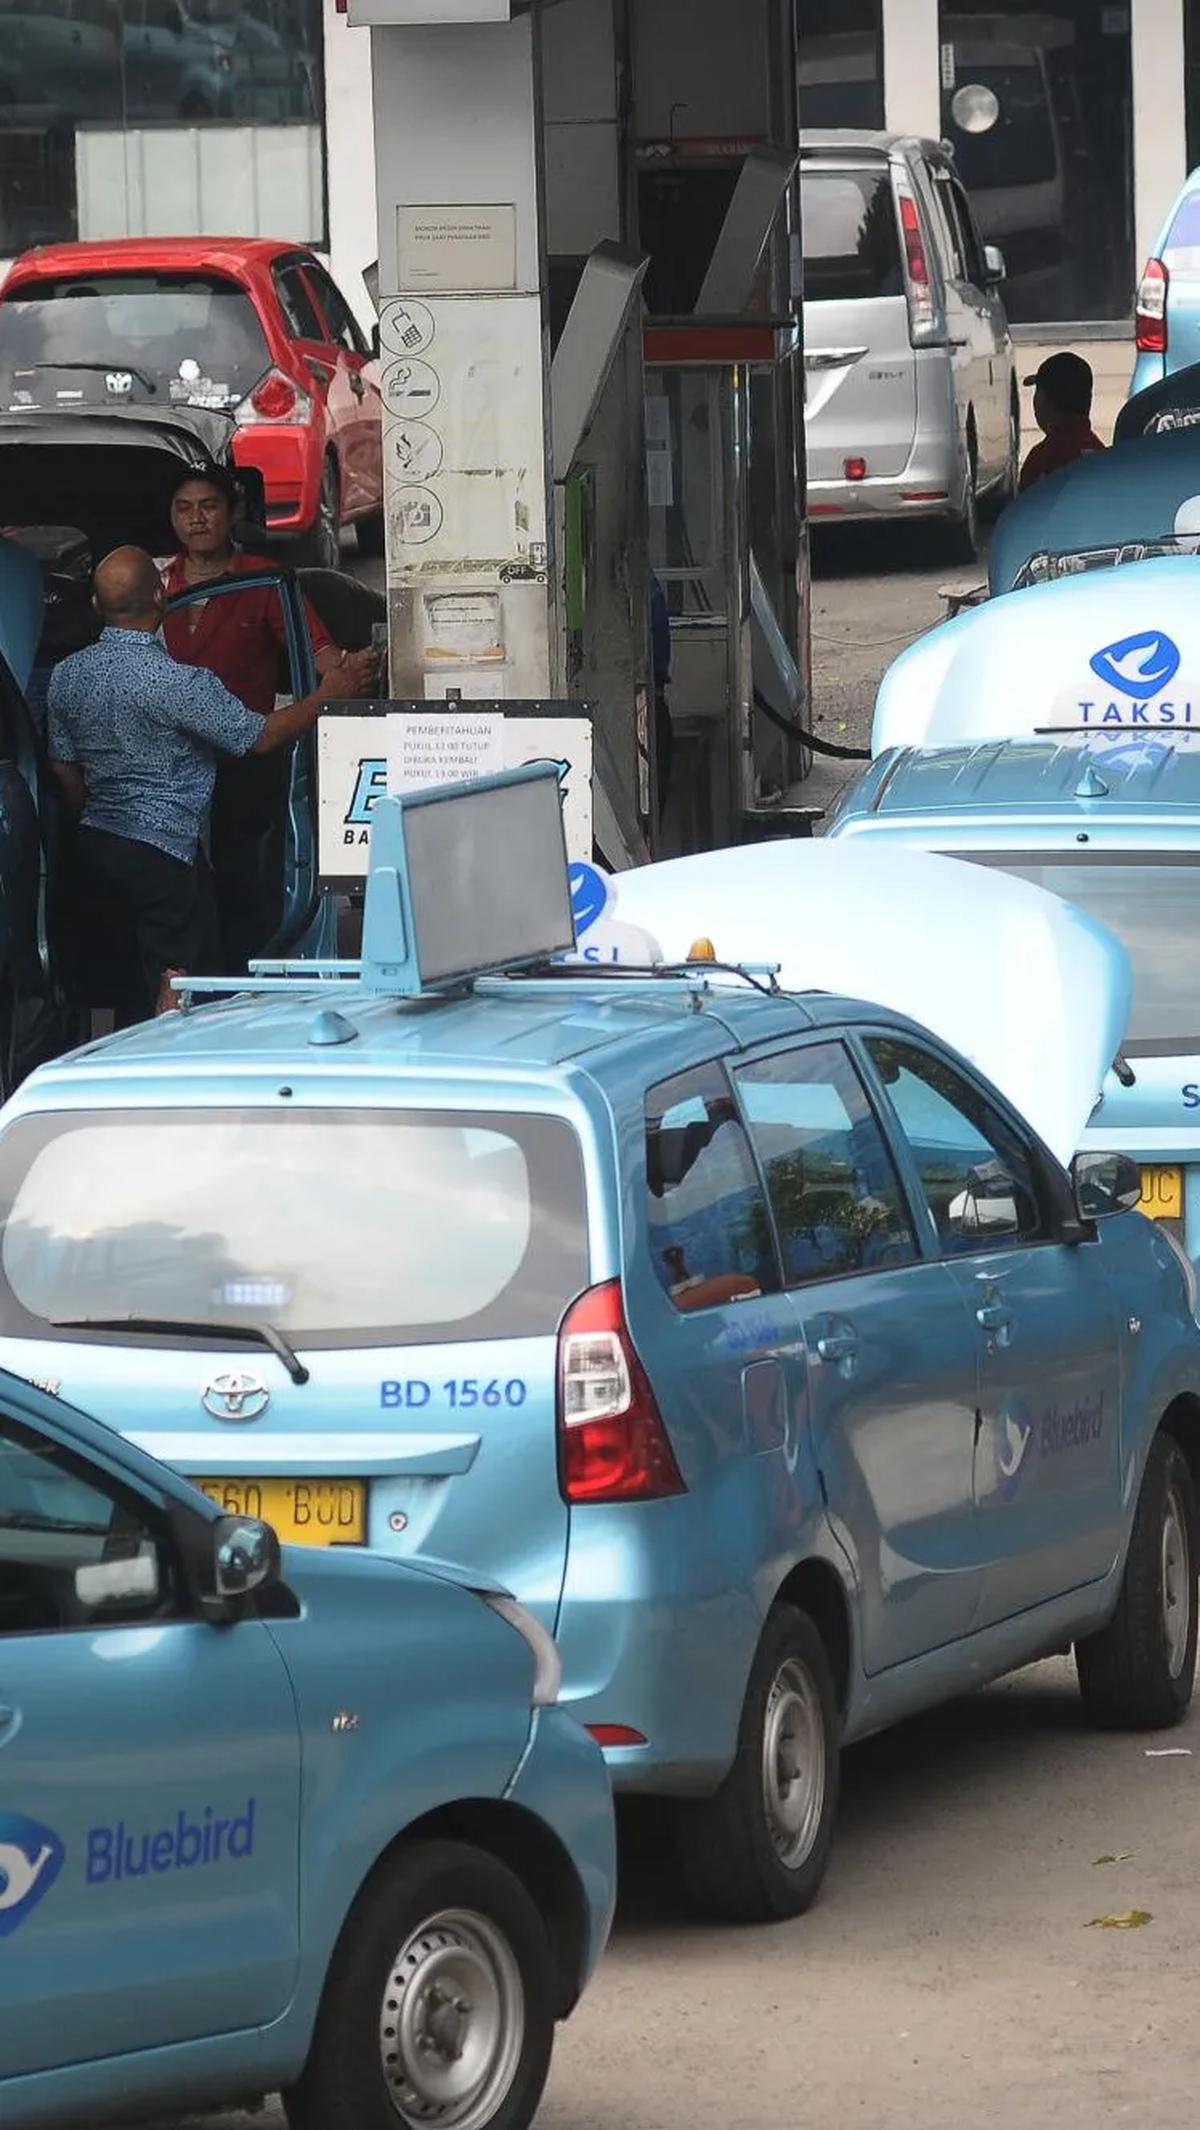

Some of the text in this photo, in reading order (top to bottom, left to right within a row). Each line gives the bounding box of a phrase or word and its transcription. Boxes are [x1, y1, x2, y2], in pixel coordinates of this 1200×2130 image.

[1077, 701, 1192, 724] TAKSI
[1181, 1083, 1200, 1108] S
[380, 1377, 527, 1409] BD 1560
[85, 1796, 257, 1885] Bluebird
